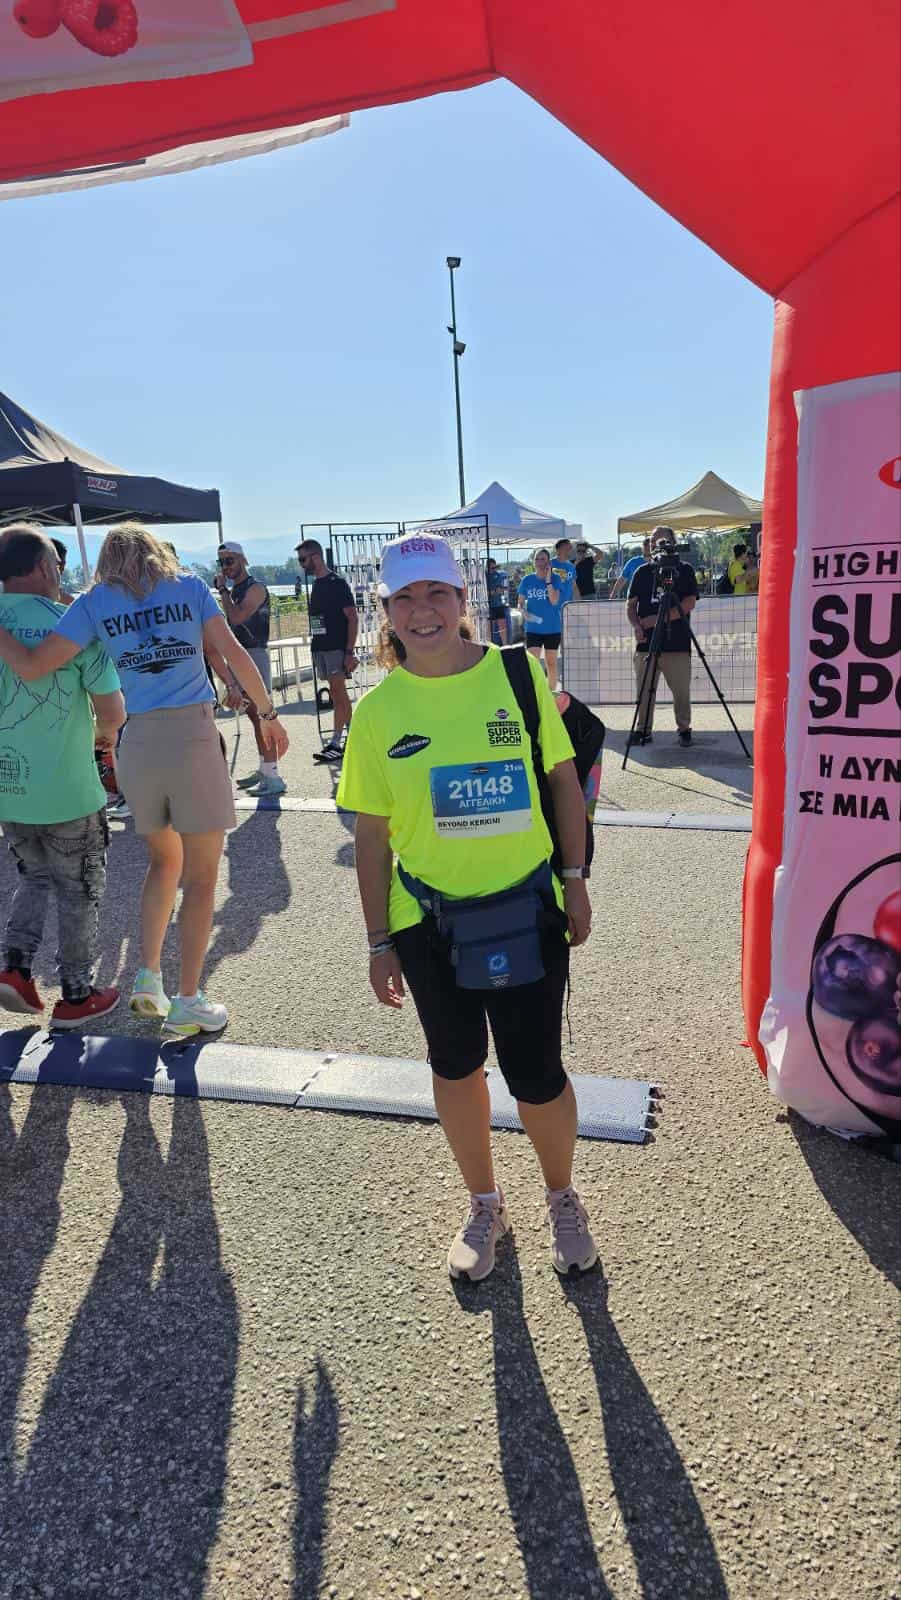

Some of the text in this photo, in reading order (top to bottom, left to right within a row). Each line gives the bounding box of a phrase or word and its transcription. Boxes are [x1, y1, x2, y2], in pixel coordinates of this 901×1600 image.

[813, 550, 898, 579] HIGH
[102, 603, 193, 638] ΕΥΑΓΓΕΛΙΑ
[809, 593, 901, 660] SU
[154, 647, 197, 660] KERKINI
[808, 662, 901, 719] SP
[488, 727, 520, 737] SUPER
[489, 735, 522, 745] SPOON
[819, 754, 901, 783] Η ΔΥΝ
[448, 775, 514, 800] 21148
[459, 796, 506, 809] ΑΓΓΕΛΙΚΗ
[799, 790, 890, 821] ΣΕ ΜΙΑ
[438, 817, 501, 829] BEYOND KERKINI
